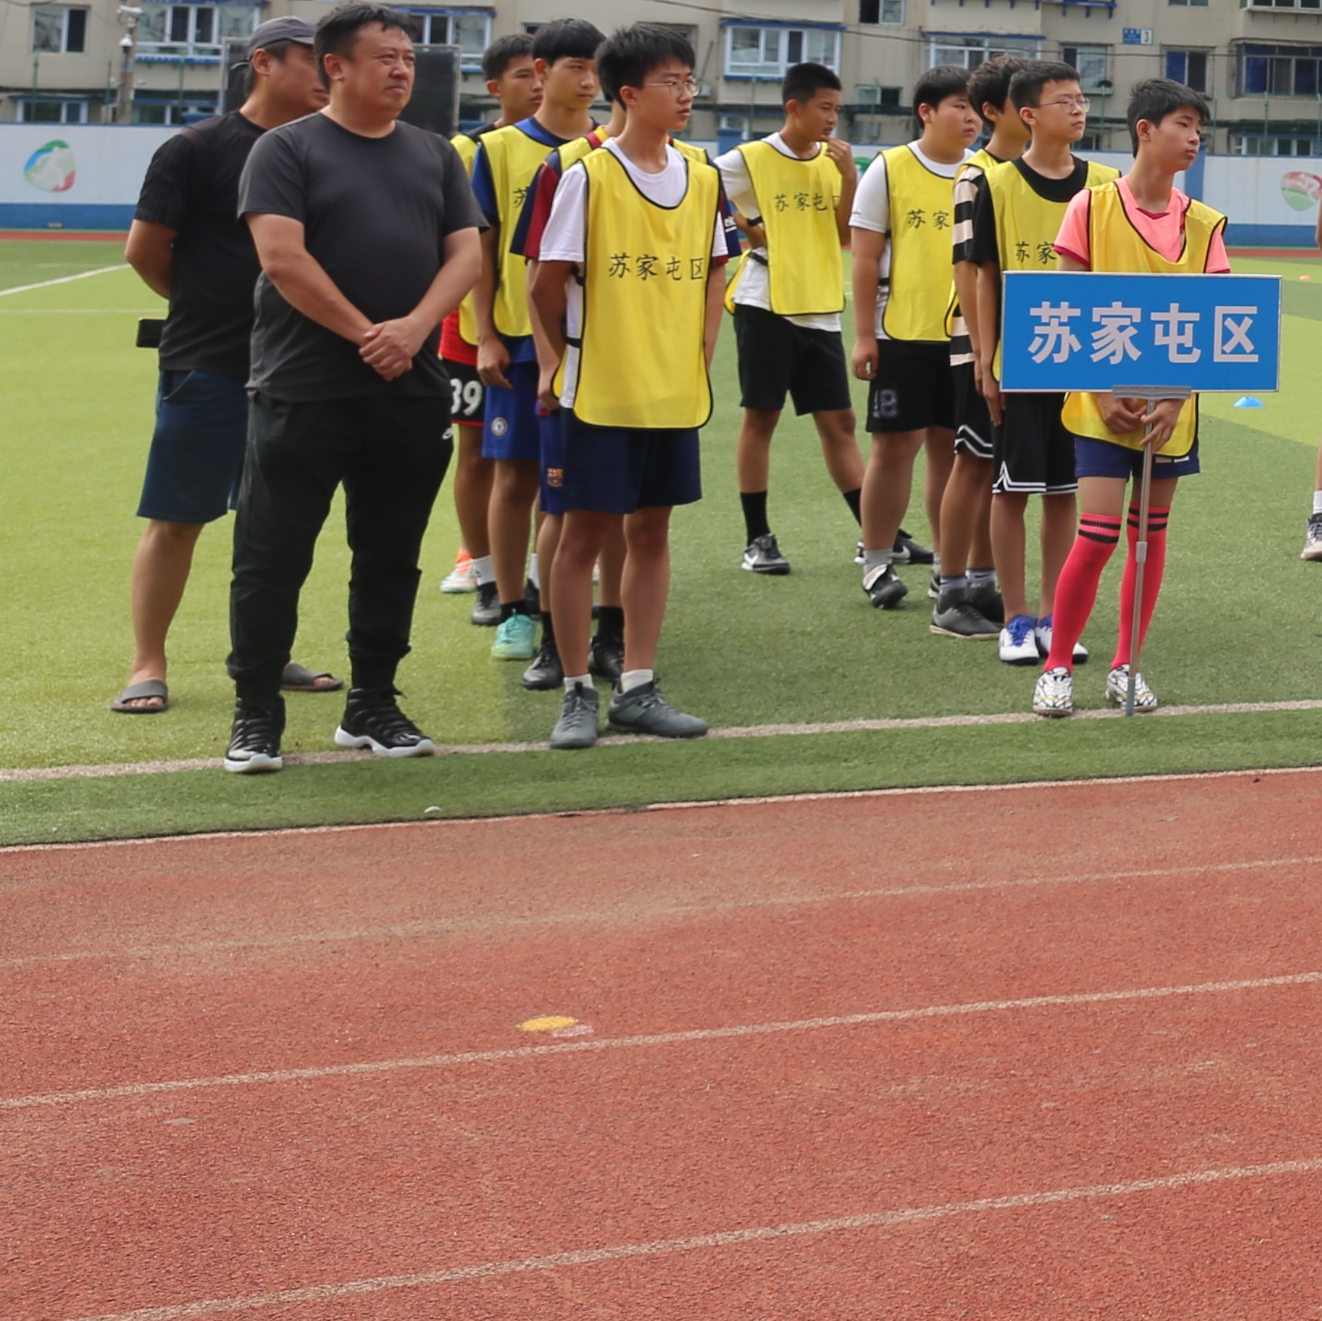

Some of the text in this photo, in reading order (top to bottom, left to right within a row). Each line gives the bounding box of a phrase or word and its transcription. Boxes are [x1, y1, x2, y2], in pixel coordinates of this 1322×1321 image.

[608, 252, 705, 281] 苏家屯区
[1028, 301, 1260, 365] 苏家屯区
